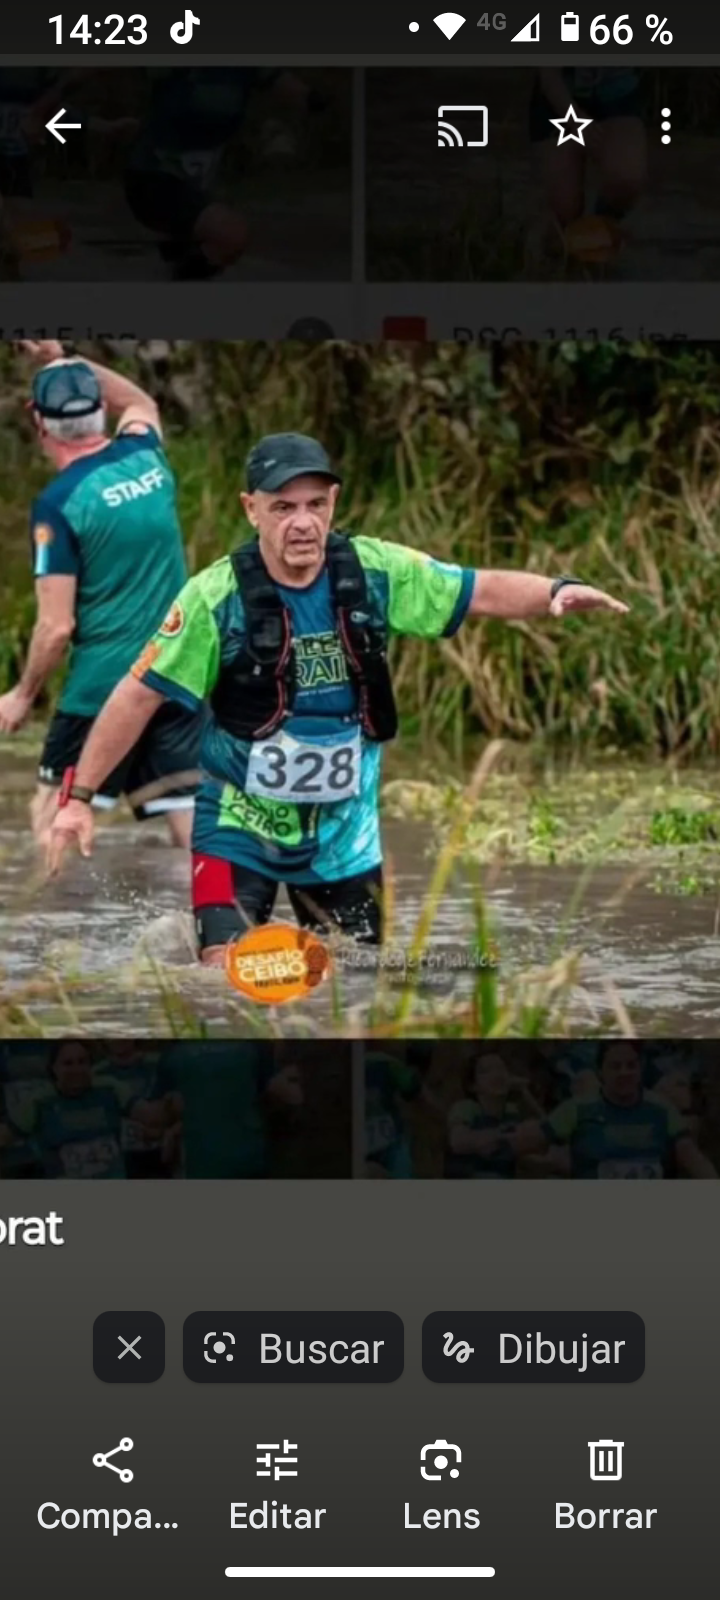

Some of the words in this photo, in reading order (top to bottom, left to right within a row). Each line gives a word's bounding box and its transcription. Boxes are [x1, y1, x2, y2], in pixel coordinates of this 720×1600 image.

[49, 13, 148, 46] 14:23
[476, 12, 507, 31] 4G
[589, 13, 634, 46] 66
[645, 13, 674, 46] %
[102, 468, 165, 507] STAFF
[256, 745, 356, 794] 328
[260, 1333, 385, 1366] Buscar
[499, 1331, 626, 1373] Dibujar
[37, 1501, 179, 1537] Compa...
[230, 1499, 327, 1530] Editar
[404, 1502, 481, 1530] Lens
[555, 1502, 658, 1530] Borrar
